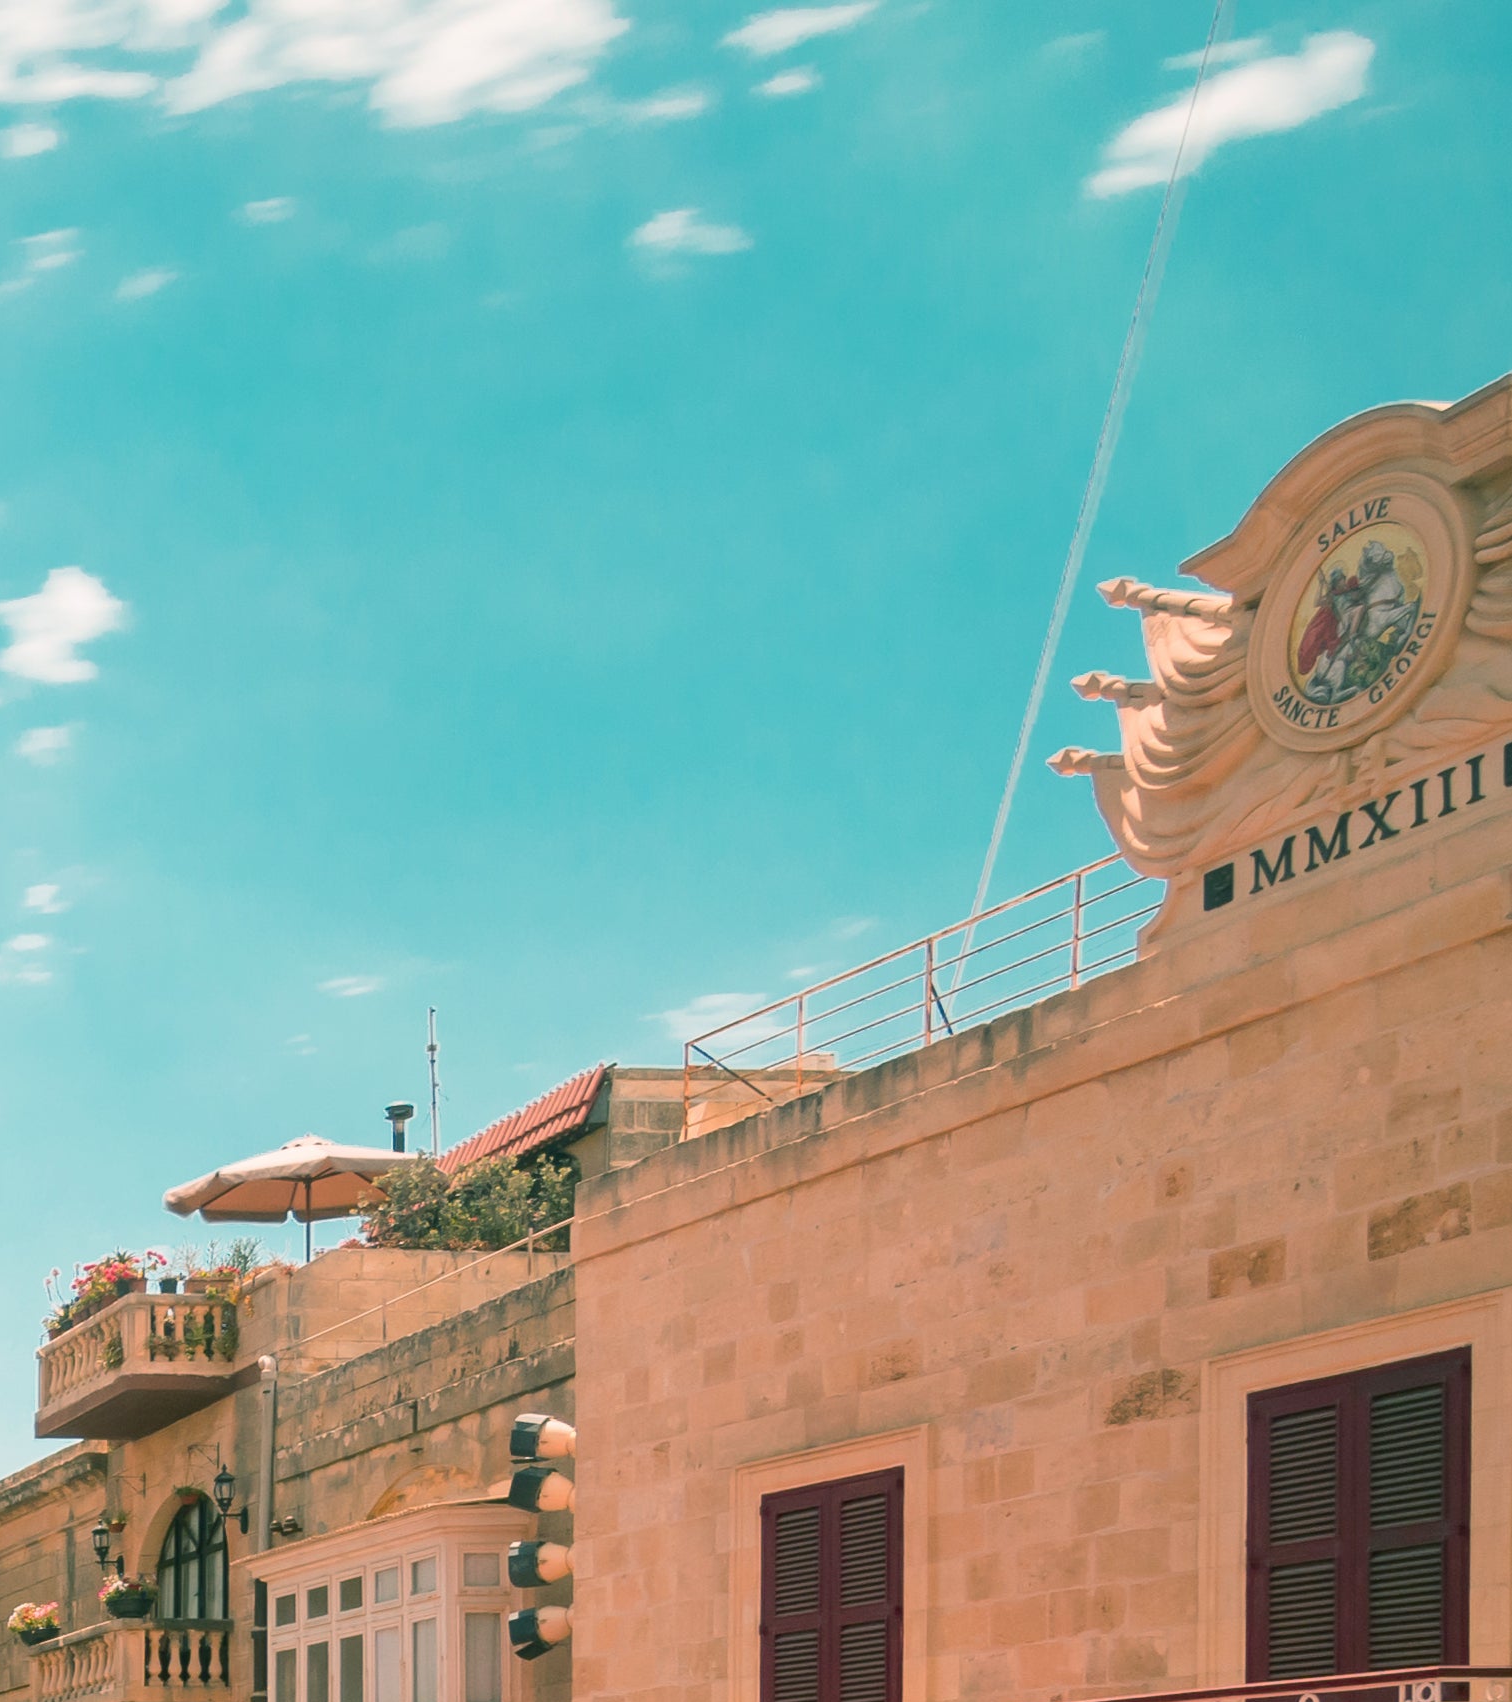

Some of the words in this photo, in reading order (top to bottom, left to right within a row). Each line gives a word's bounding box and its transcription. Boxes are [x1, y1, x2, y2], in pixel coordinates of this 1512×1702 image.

[1318, 497, 1391, 552] SALVE
[1274, 685, 1340, 727] SANCTE
[1369, 612, 1437, 704] GEORGI
[1249, 754, 1486, 894] MMXIII
